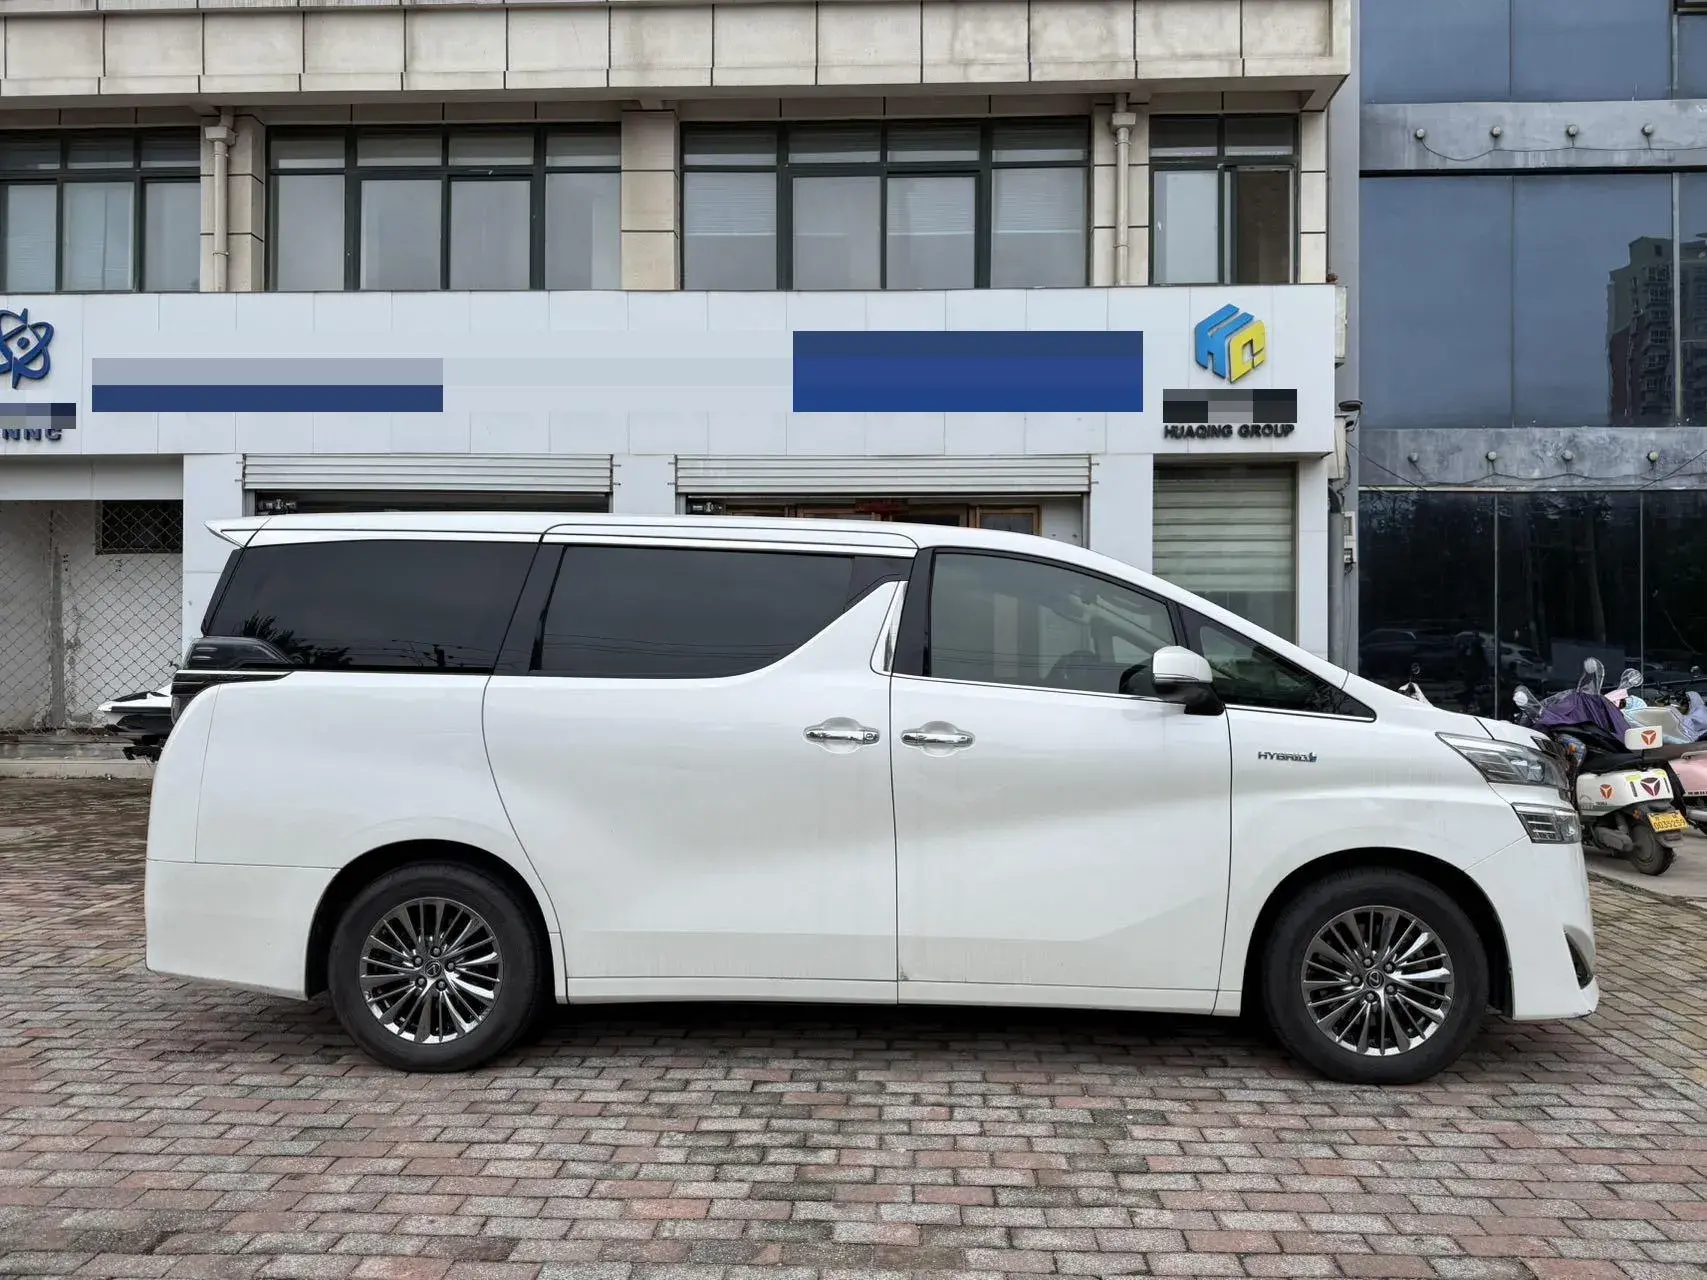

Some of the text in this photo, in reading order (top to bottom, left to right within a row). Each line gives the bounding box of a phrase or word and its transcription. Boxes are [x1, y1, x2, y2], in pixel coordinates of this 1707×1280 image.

[1164, 423, 1295, 439] HUAQING GROUP
[1257, 751, 1308, 762] HYBRID
